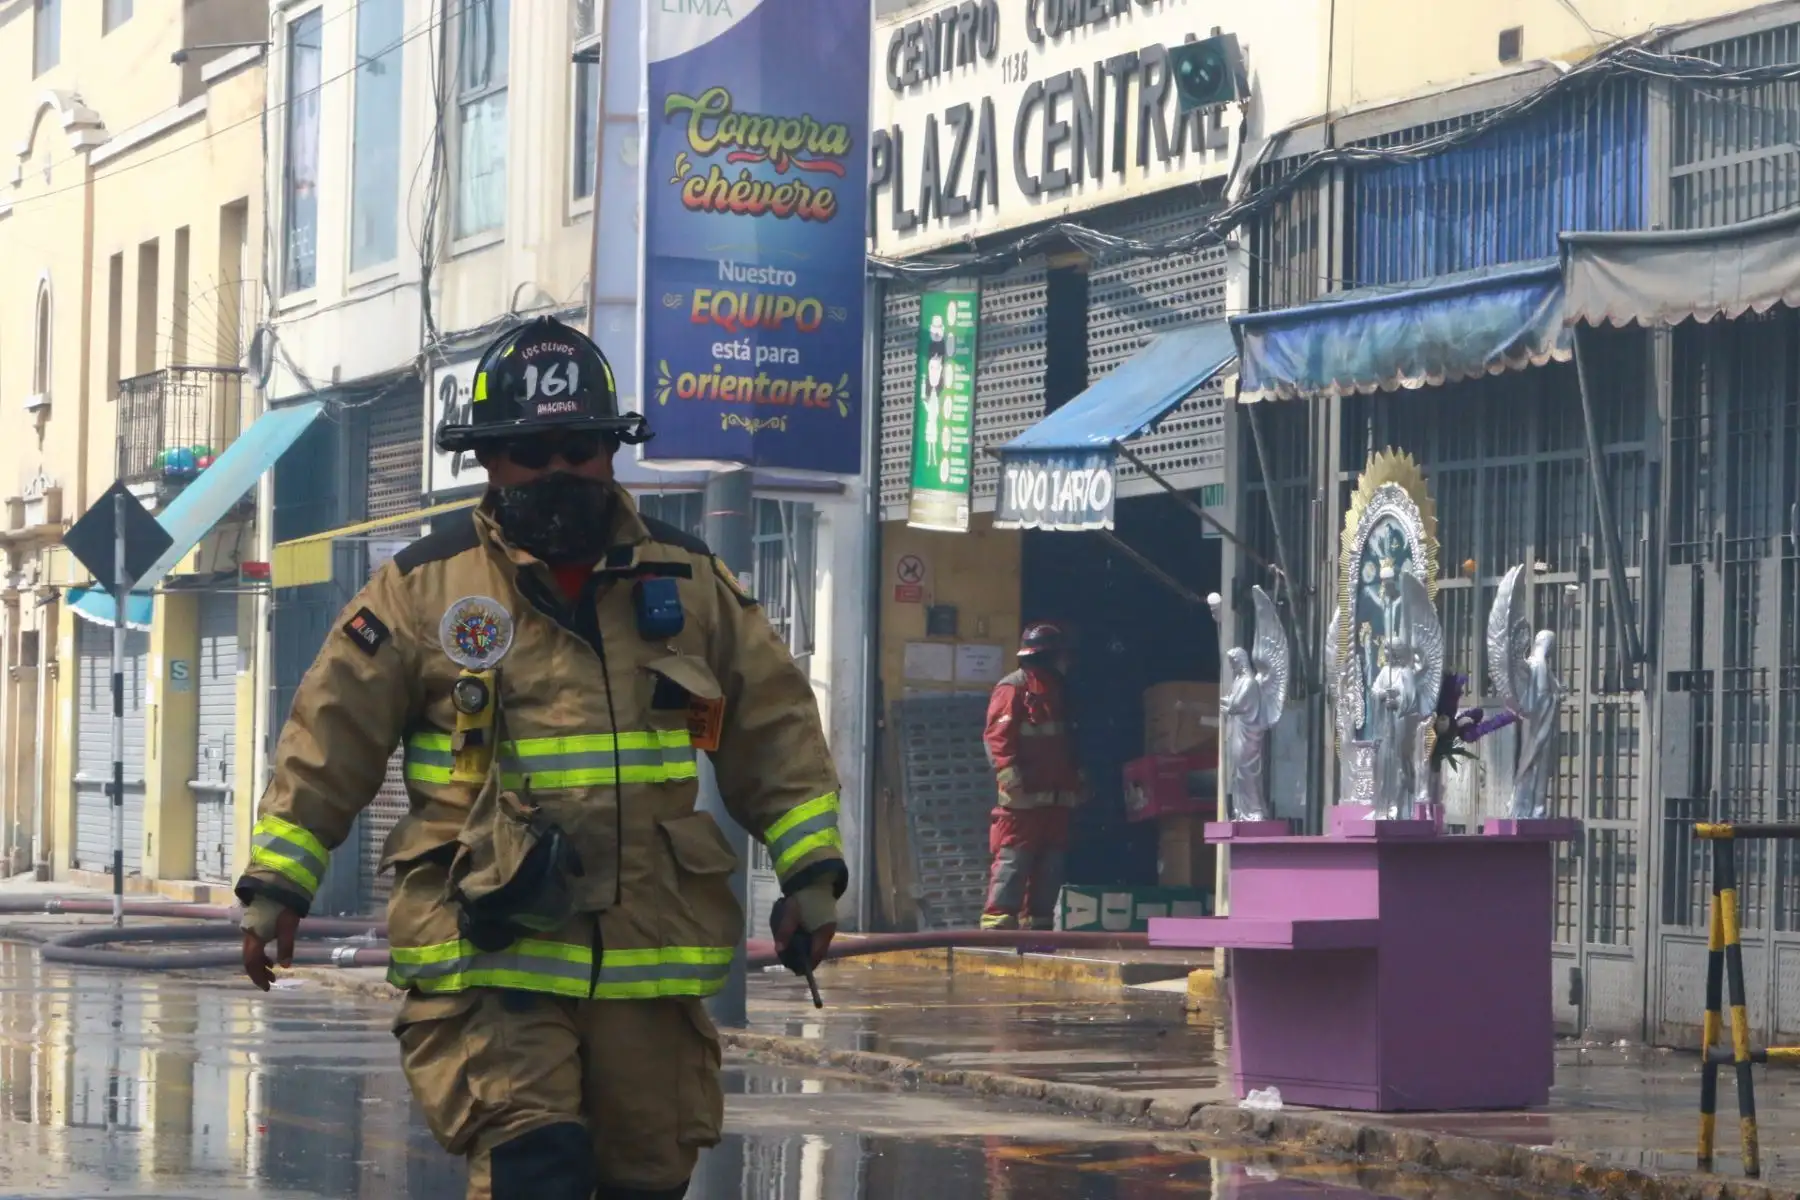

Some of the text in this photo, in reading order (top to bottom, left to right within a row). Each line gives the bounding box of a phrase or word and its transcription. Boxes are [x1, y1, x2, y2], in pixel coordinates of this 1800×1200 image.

[661, 0, 733, 18] LIMA
[886, 0, 1000, 92] CENTRO
[1001, 50, 1028, 84] 1138
[664, 86, 852, 161] Compra
[867, 96, 1000, 238] PLAZA
[682, 164, 838, 223] chévere
[718, 258, 797, 287] Nuestro
[691, 288, 824, 333] EQUIPO
[541, 342, 575, 356] OLIVOS
[711, 338, 799, 367] está para
[522, 360, 579, 401] 161
[676, 364, 833, 408] orientarte
